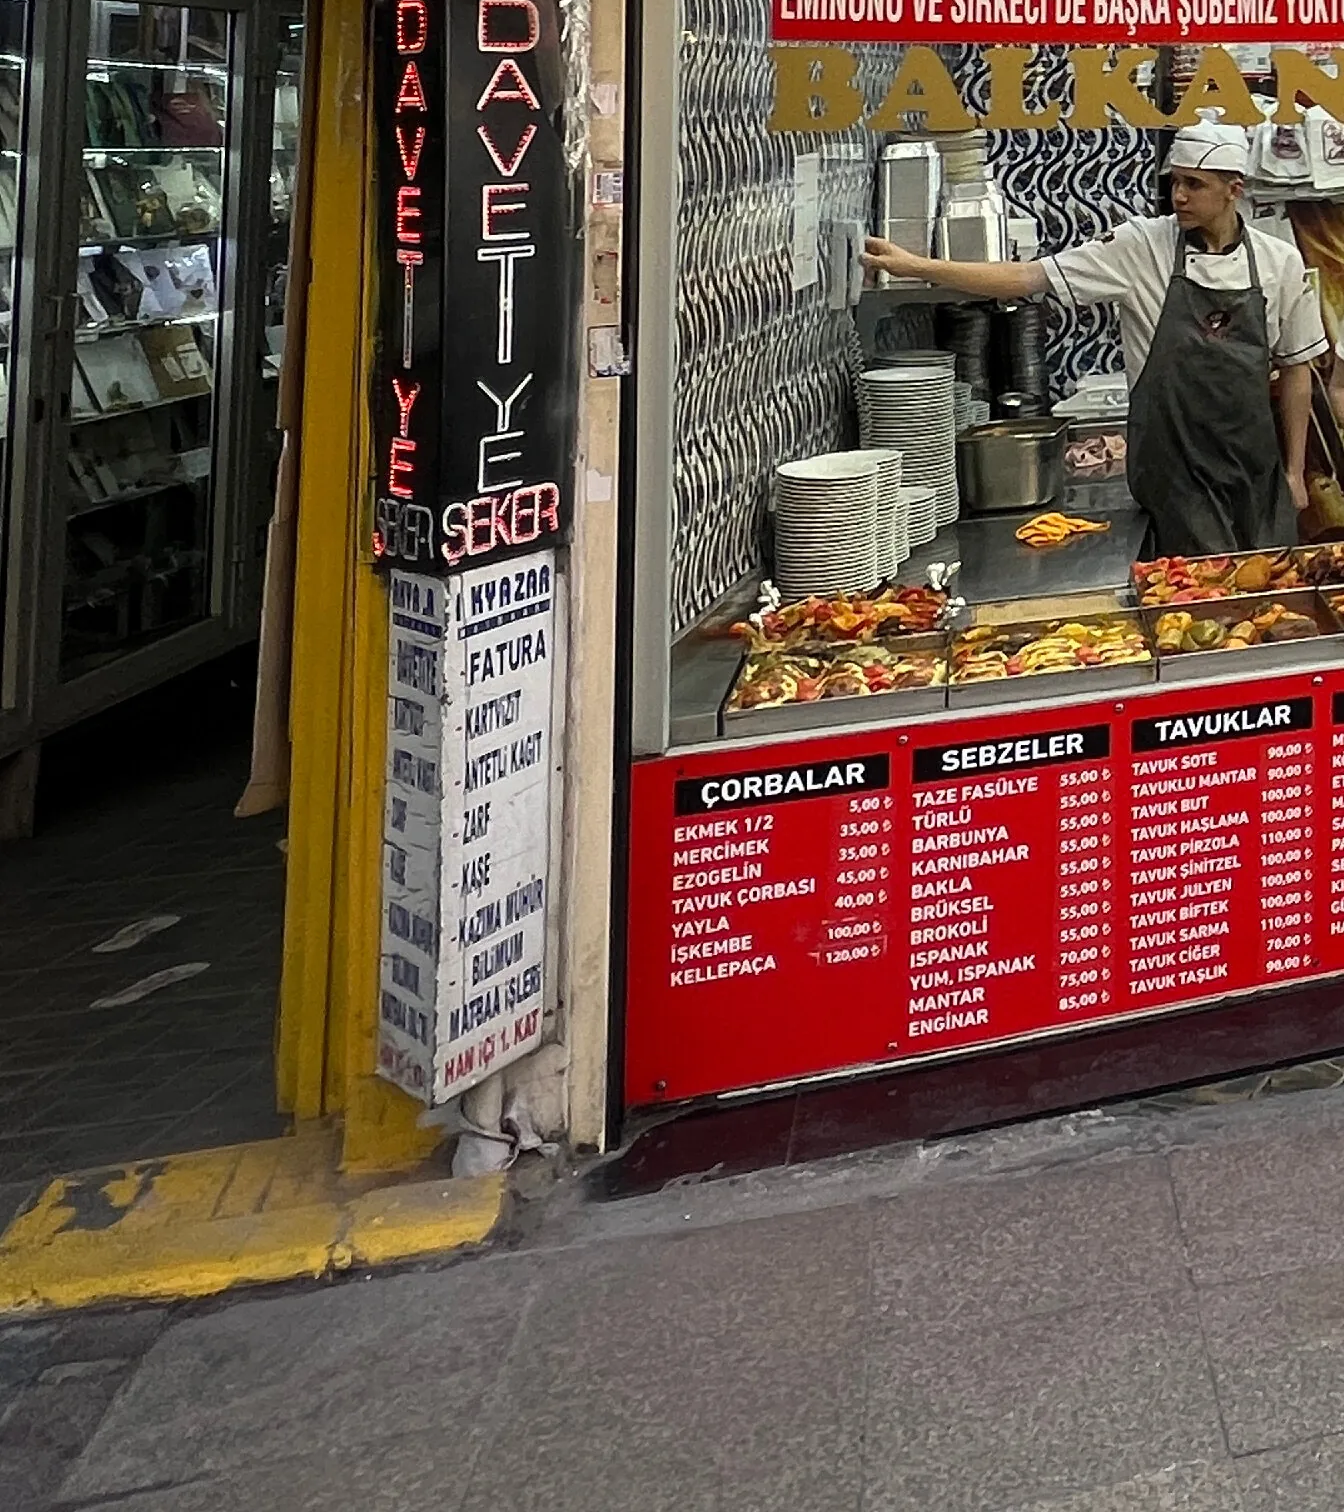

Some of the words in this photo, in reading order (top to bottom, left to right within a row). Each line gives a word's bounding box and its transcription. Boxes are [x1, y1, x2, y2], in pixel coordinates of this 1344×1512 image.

[469, 629, 546, 686] FATURA
[1155, 703, 1292, 742] TAVUKLAR
[941, 732, 1085, 772] SEBZELER
[1132, 756, 1178, 776] TAVUK
[1180, 751, 1218, 771] SOTE
[701, 763, 866, 809] ÇORBALAR
[912, 788, 958, 809] TAZE
[961, 776, 1039, 802] FASÜLYE
[1131, 775, 1196, 799] TAVUKLU
[1198, 767, 1257, 790] MANTAR
[912, 805, 972, 831] TÜRLÜ
[1131, 801, 1177, 820] TAVUK
[1181, 795, 1210, 813] BUT
[674, 819, 739, 843] EKMEK
[744, 814, 774, 833] 1/2
[911, 825, 1009, 854] BARBUNYA
[672, 837, 770, 868] MERCİMEK
[911, 844, 1030, 877] KARNIBAHAR
[672, 860, 763, 892] EZOGELİN
[911, 875, 973, 900] BAKLA
[671, 890, 733, 915] TAVUK
[736, 877, 817, 908] ÇORBASI
[910, 895, 995, 923] BRÜKSEL
[671, 916, 730, 939] YAYLA
[910, 914, 988, 945] BROKOLİ
[670, 934, 753, 965] İŞKEMBE
[910, 940, 989, 969] ISPANAK
[670, 954, 777, 987] KELLEPAÇA
[957, 954, 1036, 984] ISPANAK
[908, 986, 986, 1015] MANTAR
[908, 1008, 989, 1038] ENGİNAR
